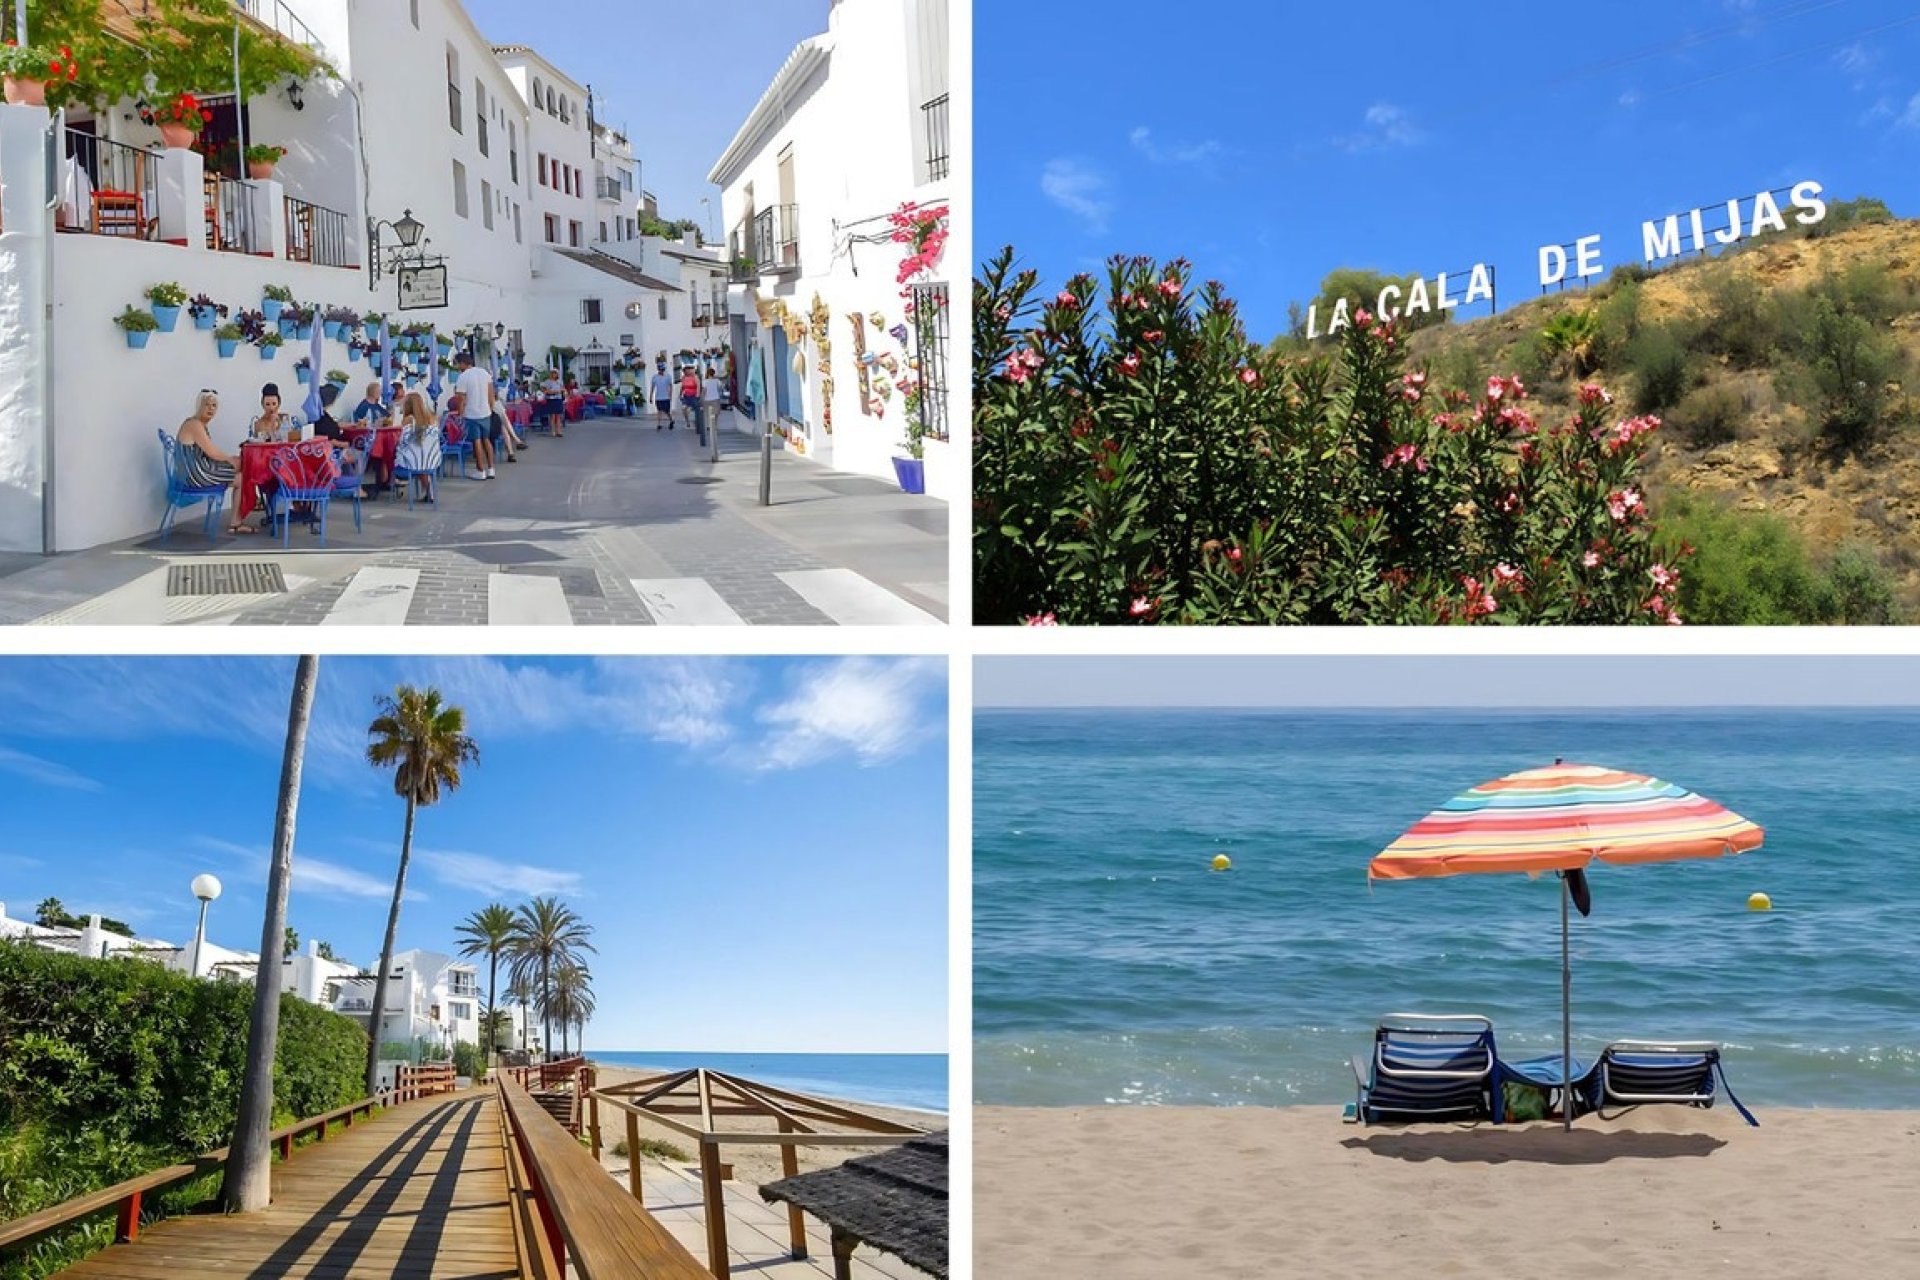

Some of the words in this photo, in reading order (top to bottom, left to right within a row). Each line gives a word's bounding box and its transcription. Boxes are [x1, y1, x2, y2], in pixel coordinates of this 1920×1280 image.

[1307, 298, 1350, 340] LA
[1377, 263, 1492, 322] CALA
[1539, 234, 1603, 285] DE
[1642, 181, 1826, 262] MIJAS
